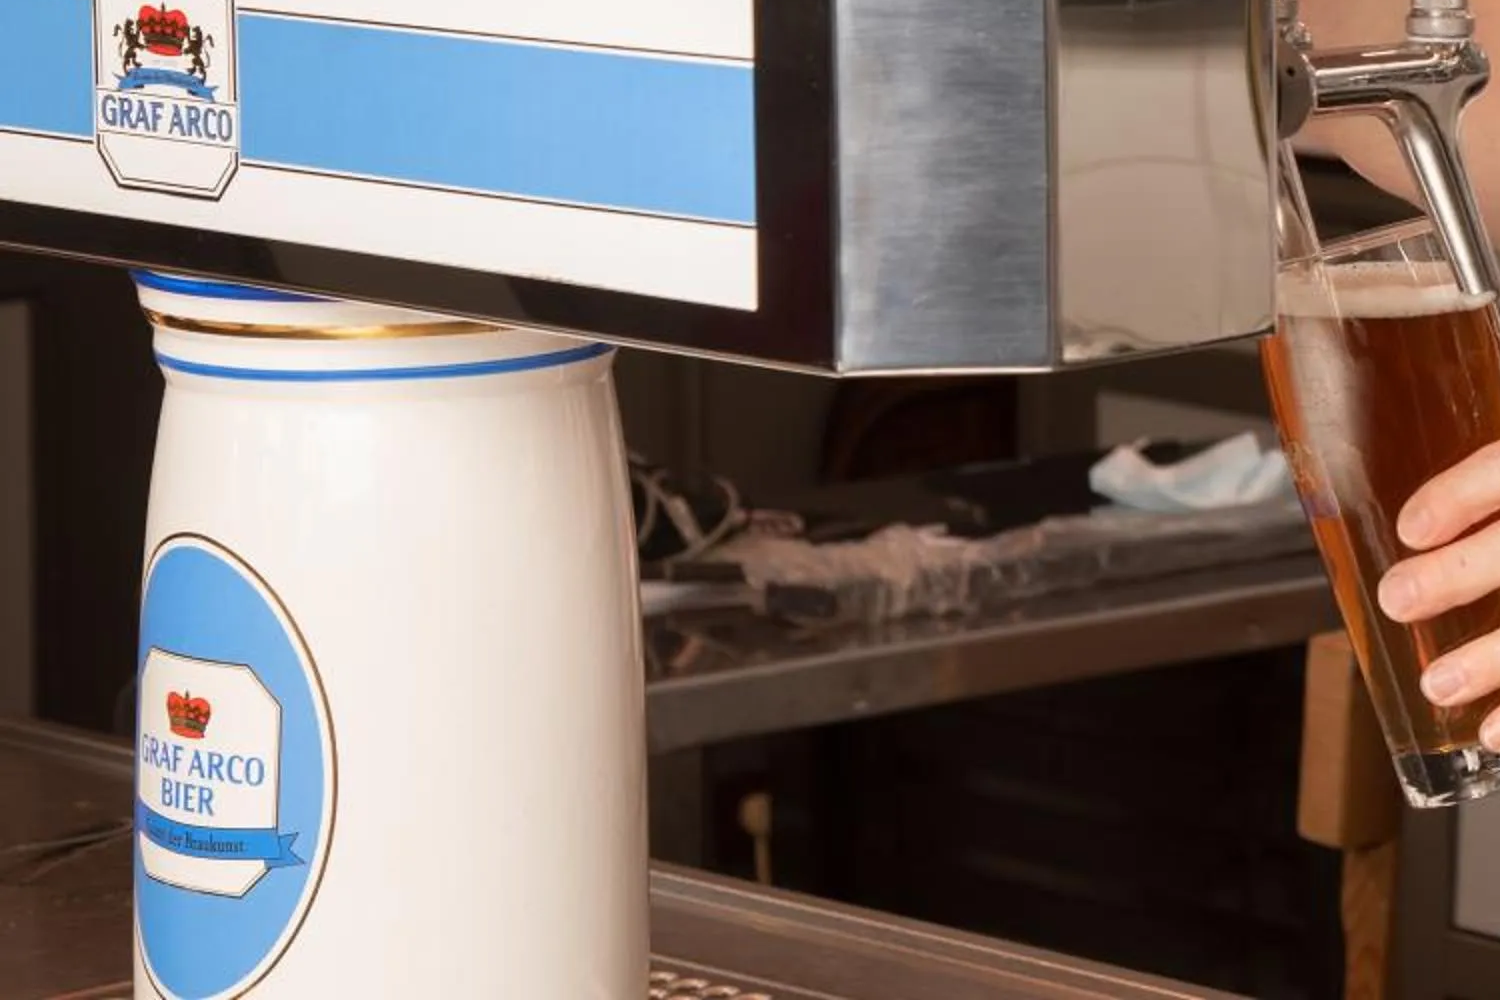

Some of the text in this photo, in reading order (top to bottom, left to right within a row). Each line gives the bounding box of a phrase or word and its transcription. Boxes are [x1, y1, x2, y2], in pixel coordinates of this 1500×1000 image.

[101, 94, 233, 142] GRAF ARCO
[142, 733, 265, 787] GRAF ARCO
[161, 777, 215, 817] BIER
